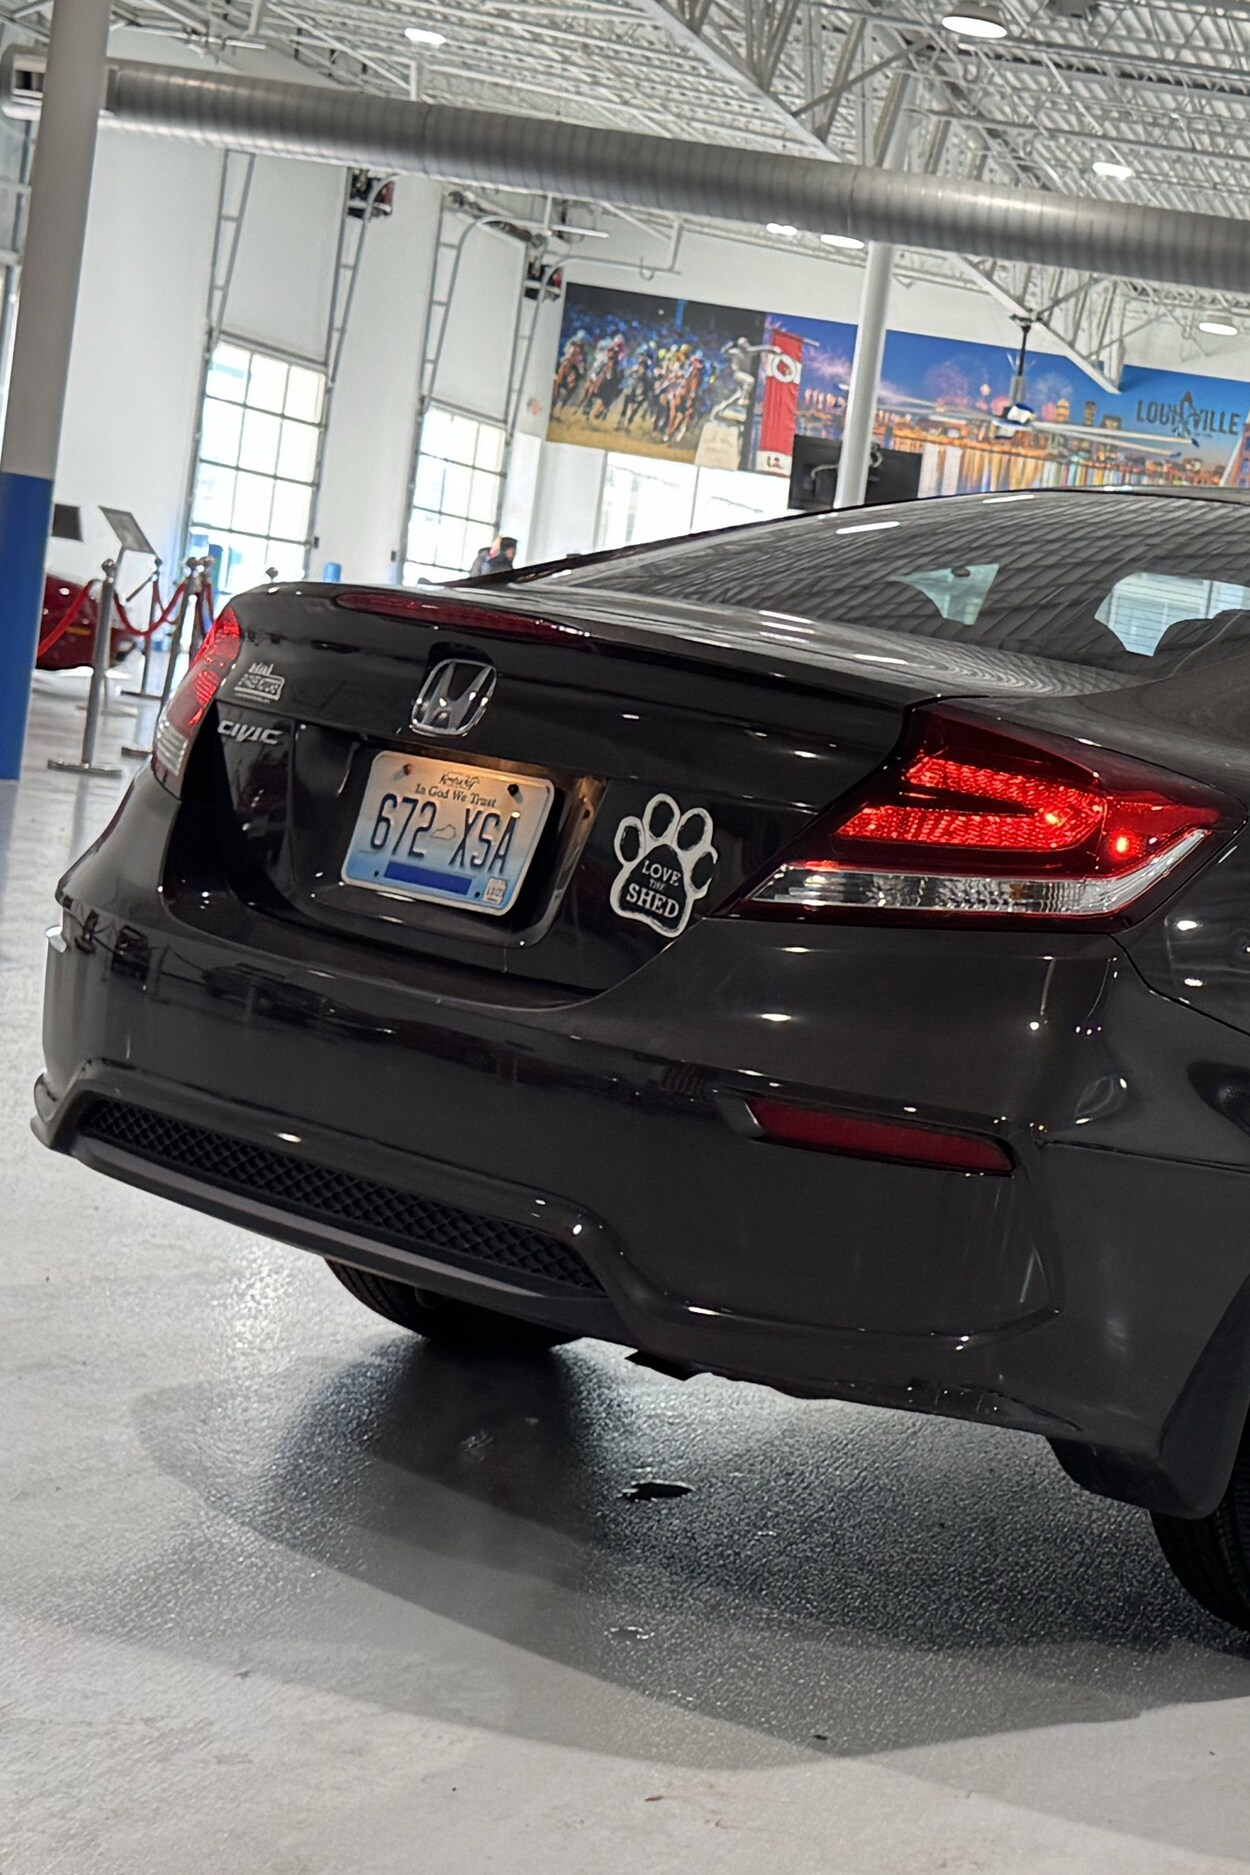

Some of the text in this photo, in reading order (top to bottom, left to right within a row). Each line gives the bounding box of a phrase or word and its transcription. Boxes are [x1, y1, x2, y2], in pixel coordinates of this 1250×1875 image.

[217, 720, 283, 745] CIVIC
[414, 783, 498, 809] In God We Trust
[370, 793, 521, 874] 672 XSA
[641, 860, 681, 886] LOVE
[625, 882, 680, 918] SHED
